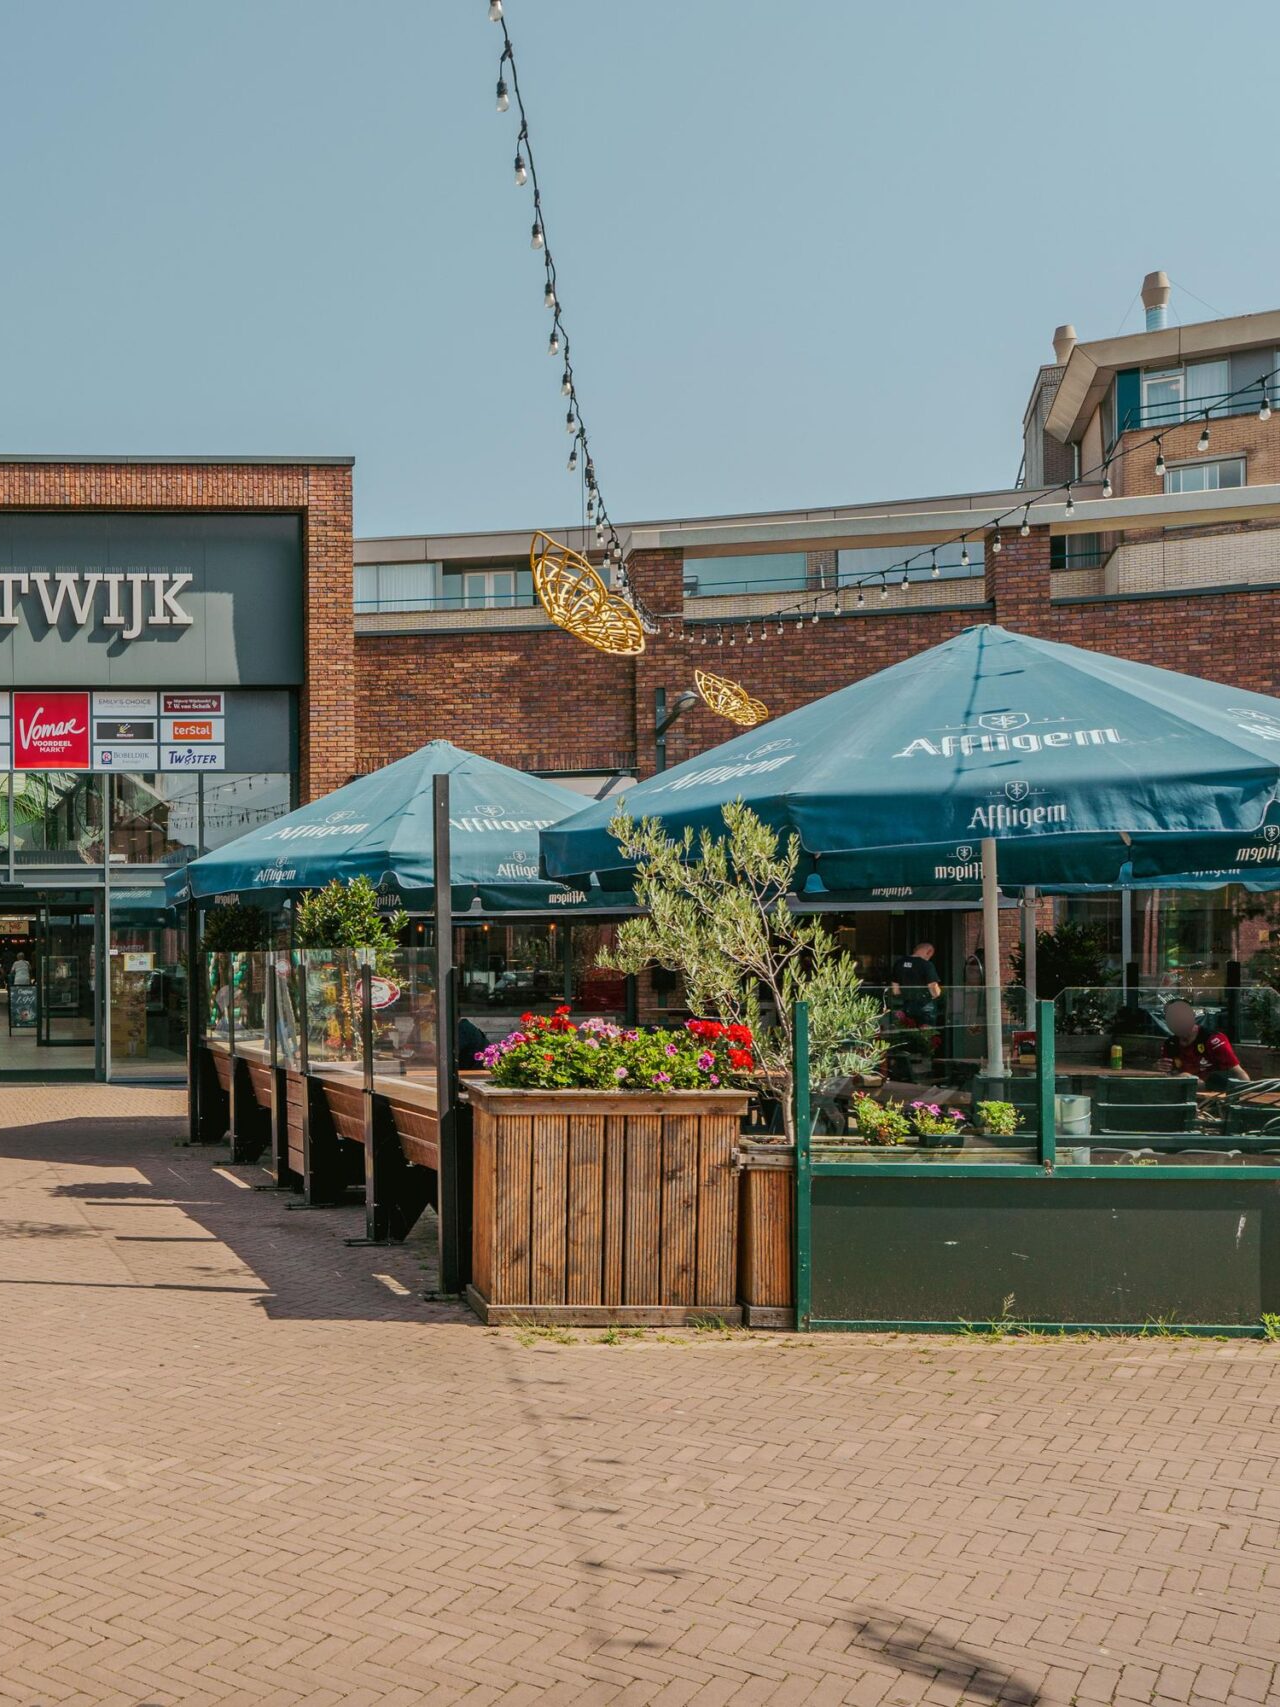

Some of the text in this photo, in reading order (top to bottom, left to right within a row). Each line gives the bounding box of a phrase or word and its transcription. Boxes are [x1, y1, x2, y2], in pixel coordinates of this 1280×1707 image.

[174, 726, 210, 735] terStal
[892, 728, 1121, 758] Affligem
[168, 748, 217, 765] TWISTER
[967, 804, 1066, 830] Affligem
[264, 822, 370, 841] Affligem
[254, 868, 296, 883] Affligem
[496, 863, 540, 879] Afflige
